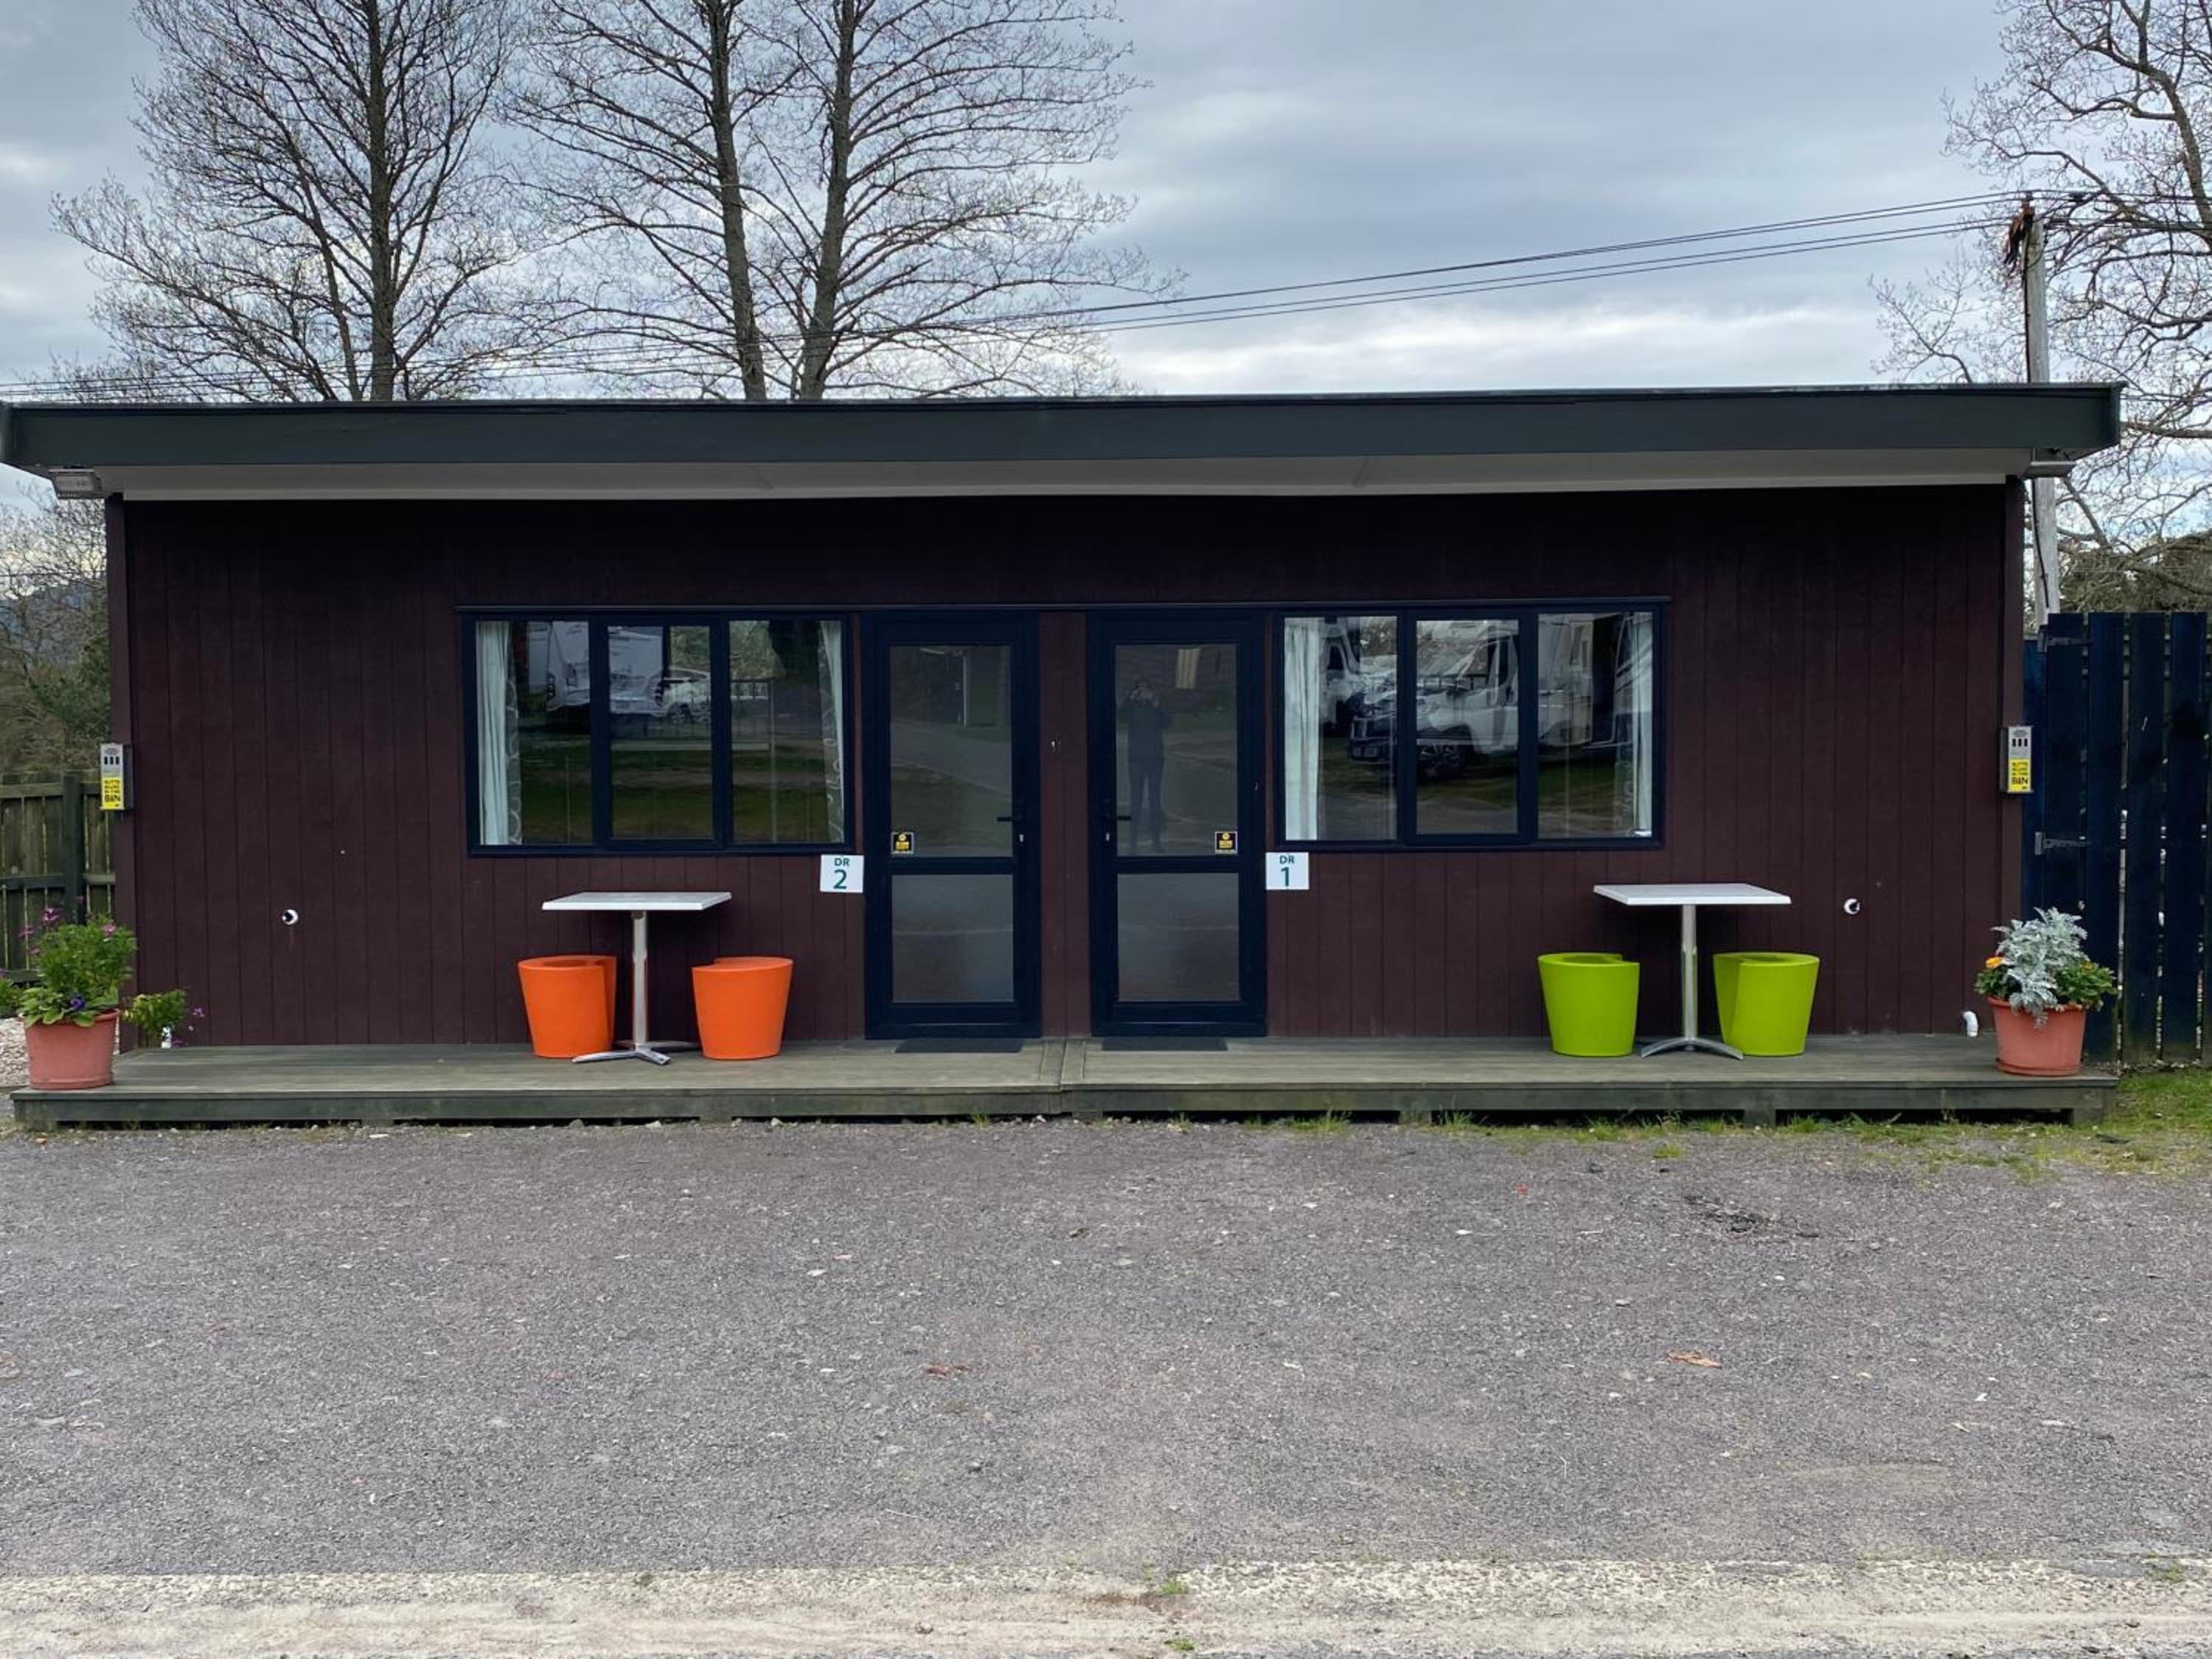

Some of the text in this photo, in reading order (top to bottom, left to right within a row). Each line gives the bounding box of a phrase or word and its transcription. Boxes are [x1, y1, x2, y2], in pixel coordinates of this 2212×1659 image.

[834, 858, 849, 866] DR
[1279, 855, 1295, 864] DR
[833, 869, 847, 889] 2
[1281, 866, 1290, 887] 1
